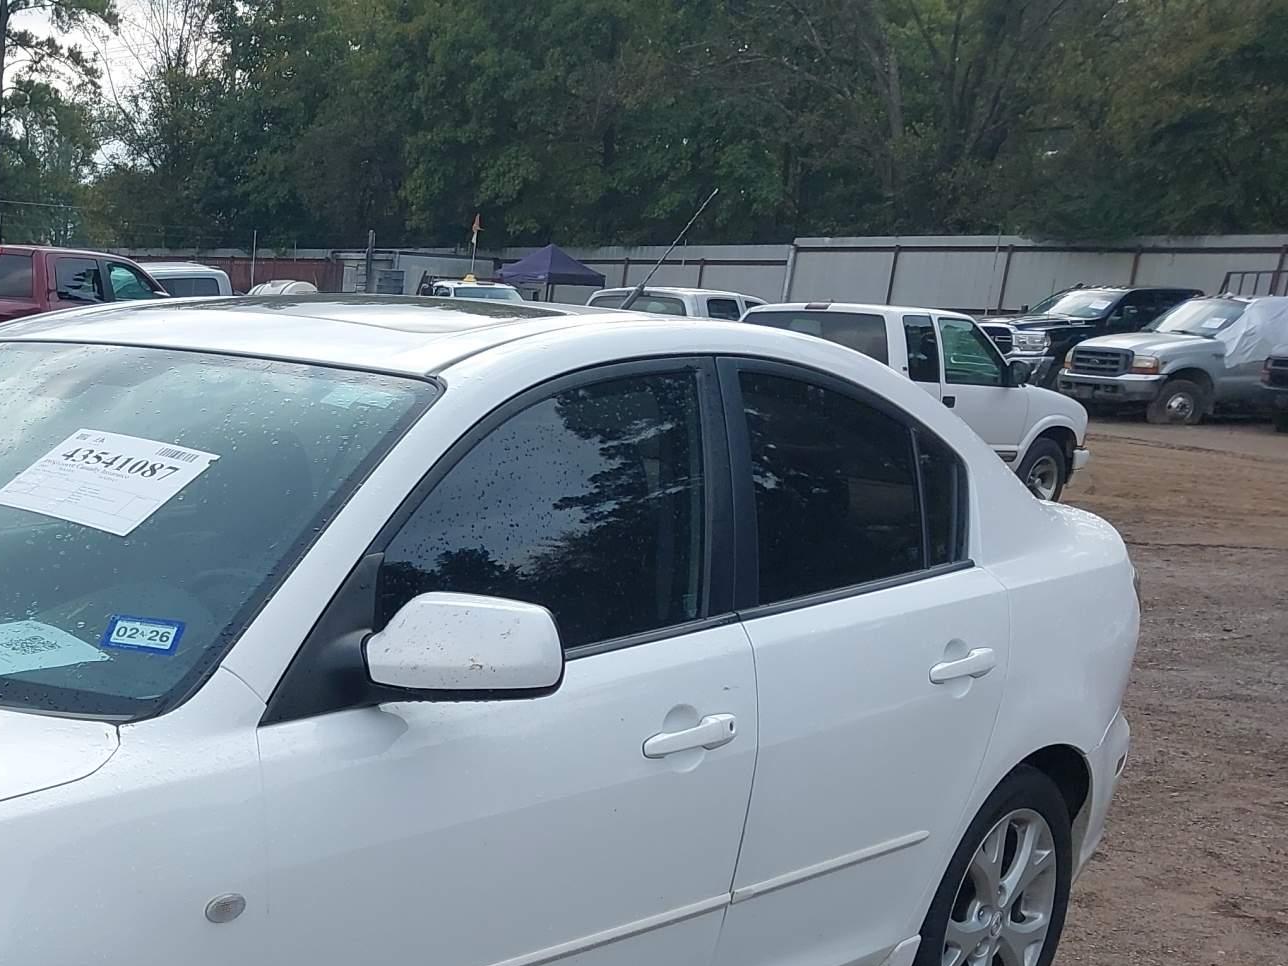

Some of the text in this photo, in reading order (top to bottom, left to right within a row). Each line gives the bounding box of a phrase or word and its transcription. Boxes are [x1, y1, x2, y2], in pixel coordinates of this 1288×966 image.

[62, 447, 180, 481] 43541087
[115, 626, 172, 643] 02 26
